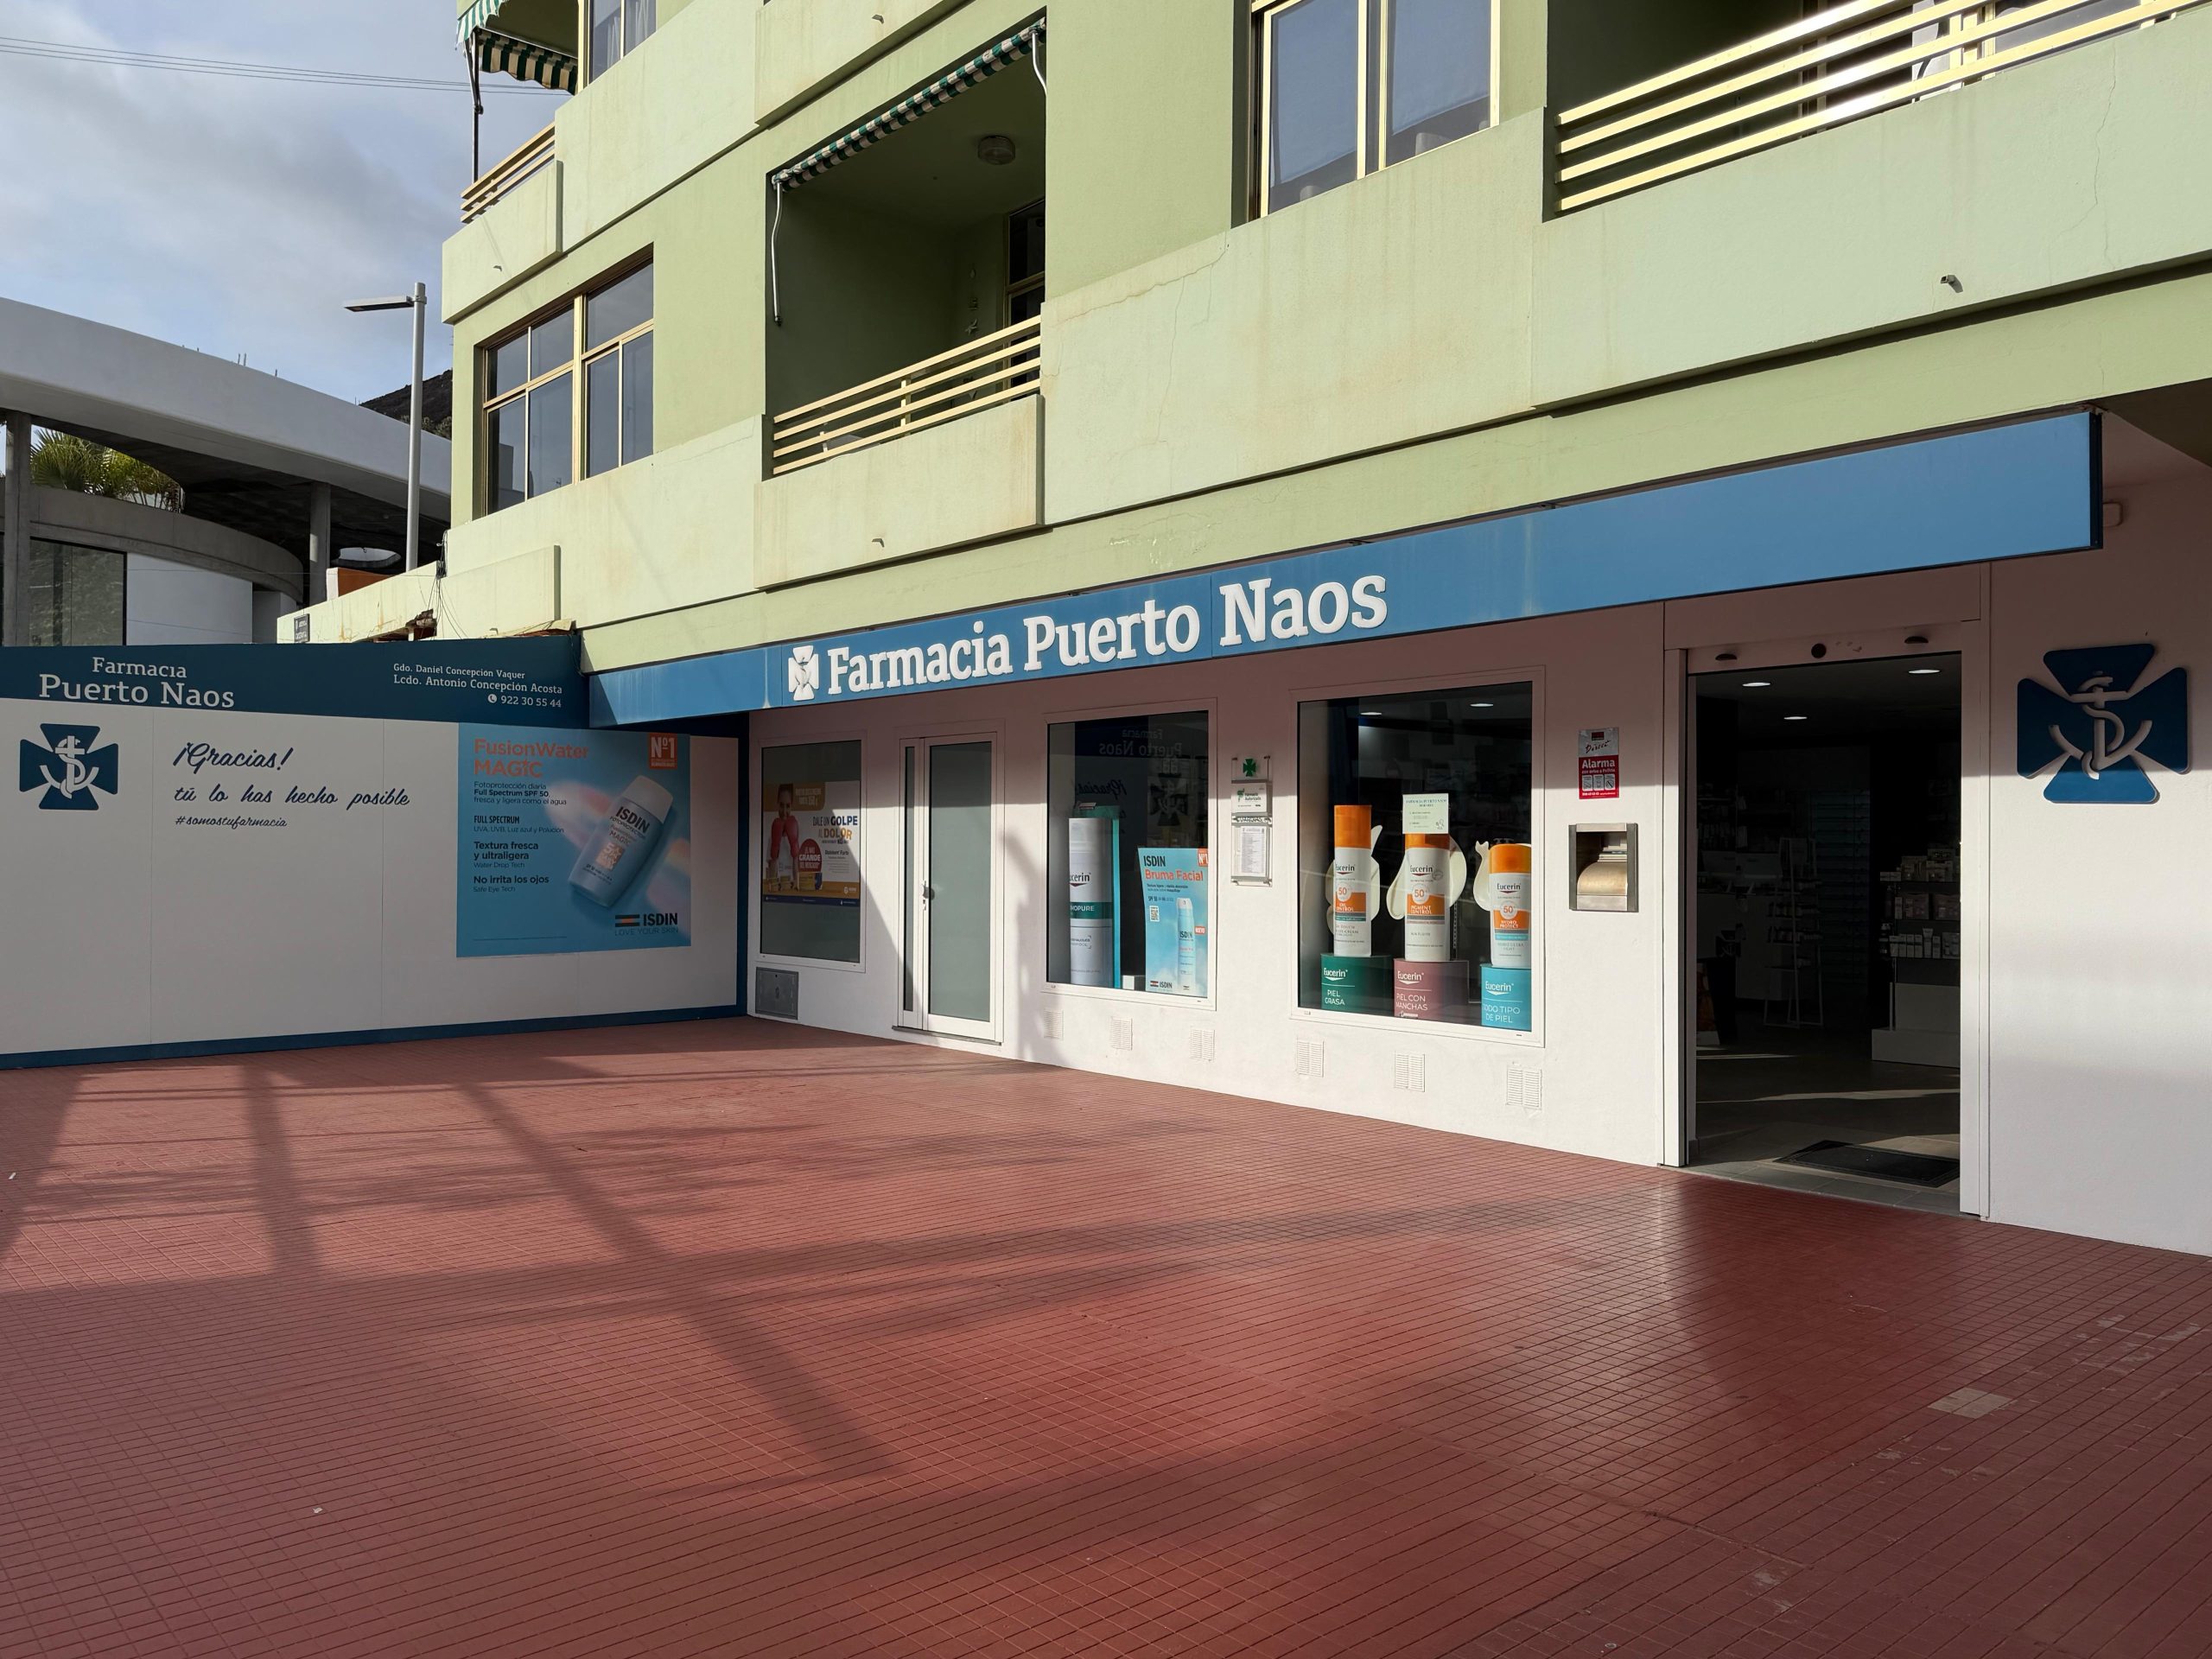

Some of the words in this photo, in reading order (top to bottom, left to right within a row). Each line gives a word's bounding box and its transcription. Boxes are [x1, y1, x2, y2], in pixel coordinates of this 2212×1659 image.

[827, 620, 1013, 696] Farmacia
[1023, 599, 1201, 671] Puerto
[1218, 575, 1388, 646] Naos
[92, 656, 188, 678] Farmacia
[393, 663, 413, 672] Gdo.
[416, 664, 443, 674] Daniel
[446, 666, 493, 677] Concepción
[496, 670, 525, 680] Vaquer
[393, 674, 422, 685] Lcdo.
[425, 676, 467, 688] Antonio
[470, 679, 528, 692] Concepción
[530, 683, 563, 694] Acosta
[39, 673, 149, 703] Puerto
[160, 681, 235, 708] Naos
[500, 695, 519, 705] 922
[521, 696, 534, 706] 30
[536, 697, 548, 707] 55
[549, 698, 563, 708] 44
[474, 738, 589, 759] FusionWater
[172, 741, 294, 775] ¡Gracias!
[1581, 759, 1616, 769] Alarma
[474, 781, 526, 791] Fotoprotección
[528, 781, 547, 790] diaria
[174, 786, 197, 802] tú
[208, 783, 229, 802] lo
[240, 784, 272, 803] has
[284, 785, 339, 804] hecho
[346, 787, 410, 810] posible
[502, 797, 521, 805] ligera
[175, 815, 288, 830] #somostufarmacia
[474, 815, 487, 823] FULL
[489, 815, 520, 824] SPECTRUM
[615, 806, 650, 834] ISDIN
[830, 816, 858, 826] GOLPE
[823, 828, 853, 840] DOLOR
[474, 841, 508, 849] Textura
[511, 841, 539, 849] fresca
[482, 851, 529, 861] ultraligera
[1143, 855, 1166, 867] ISDIN
[474, 875, 487, 884] No
[490, 875, 512, 884] irrita
[514, 874, 528, 883] los
[530, 874, 550, 885] ojos
[1145, 868, 1174, 880] Bruma
[1176, 870, 1204, 881] Facial
[643, 912, 678, 927] ISDIN
[615, 928, 635, 937] LOVE
[638, 926, 661, 935] YOUR
[662, 925, 679, 934] SKIN
[1323, 968, 1346, 977] Eucerin
[1397, 970, 1422, 981] Eucerin
[1485, 981, 1511, 992] Eucerin
[1325, 997, 1345, 1006] GRASA
[1395, 1001, 1428, 1010] MANCHAS
[1483, 1003, 1498, 1013] TODO
[1499, 1006, 1521, 1014] TIPO
[1495, 1014, 1513, 1023] PIEL
